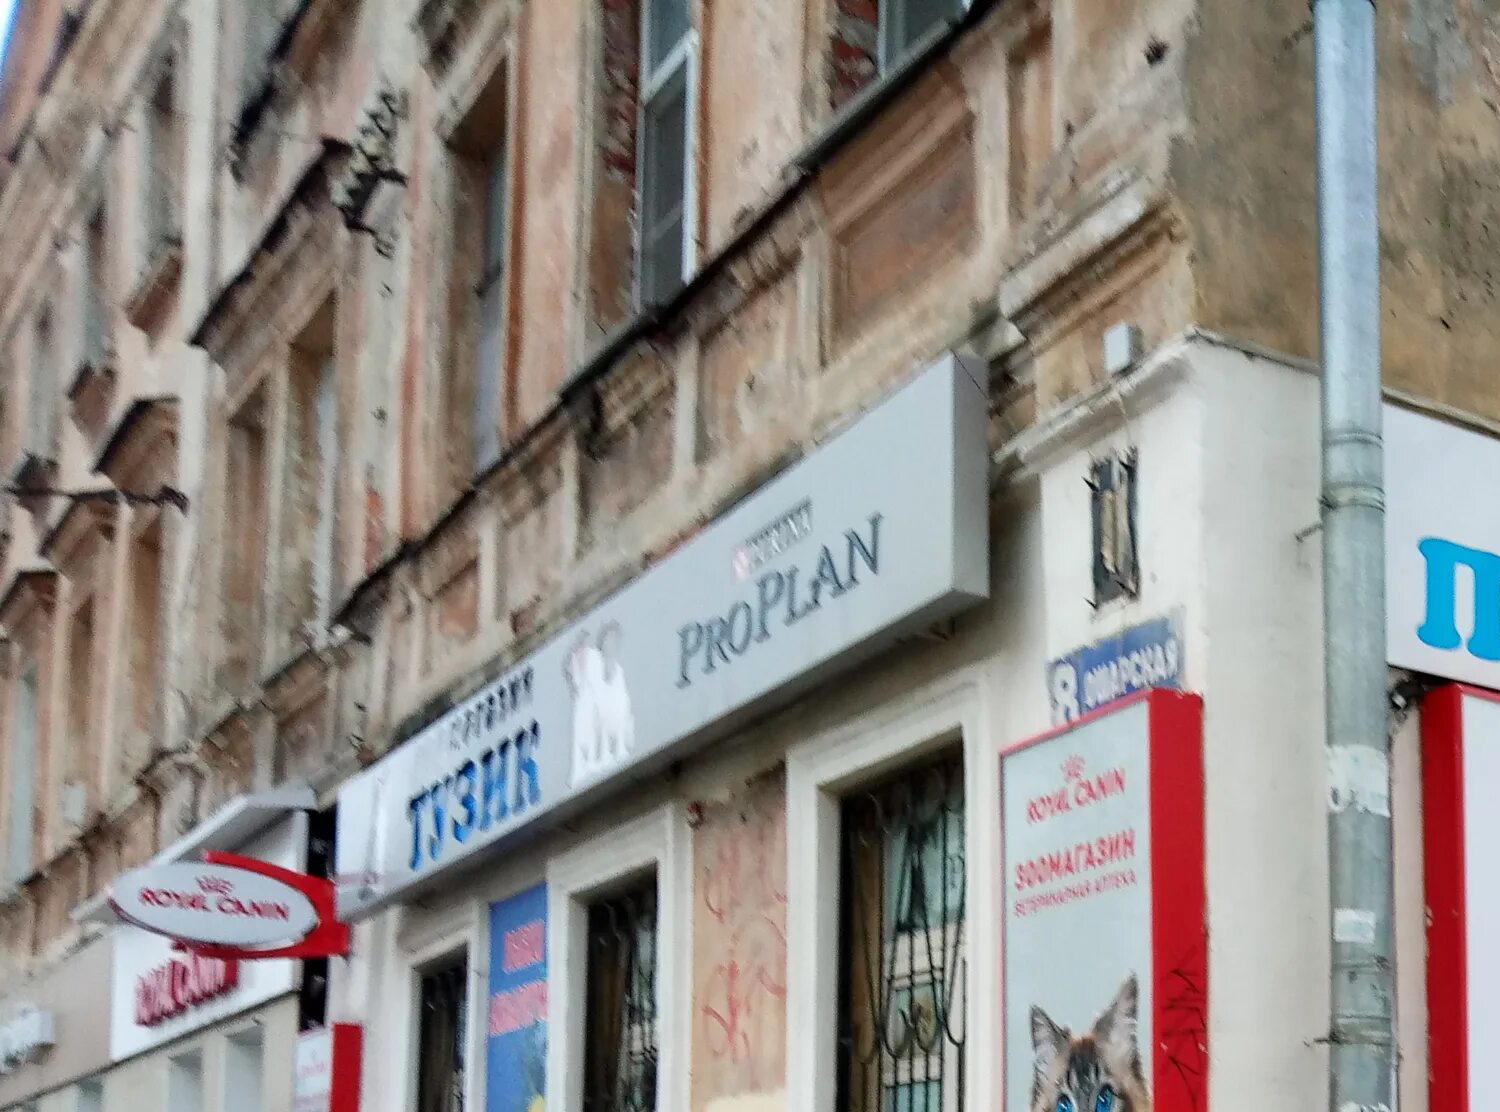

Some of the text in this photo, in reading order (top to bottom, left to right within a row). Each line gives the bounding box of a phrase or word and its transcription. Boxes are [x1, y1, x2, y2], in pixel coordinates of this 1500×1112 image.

[408, 717, 542, 873] ТУЗИК
[1028, 768, 1127, 824] ROYAL CANIN
[1015, 826, 1136, 892] ЗООМАГАЗИН
[139, 886, 290, 922] ROYAL CANIN
